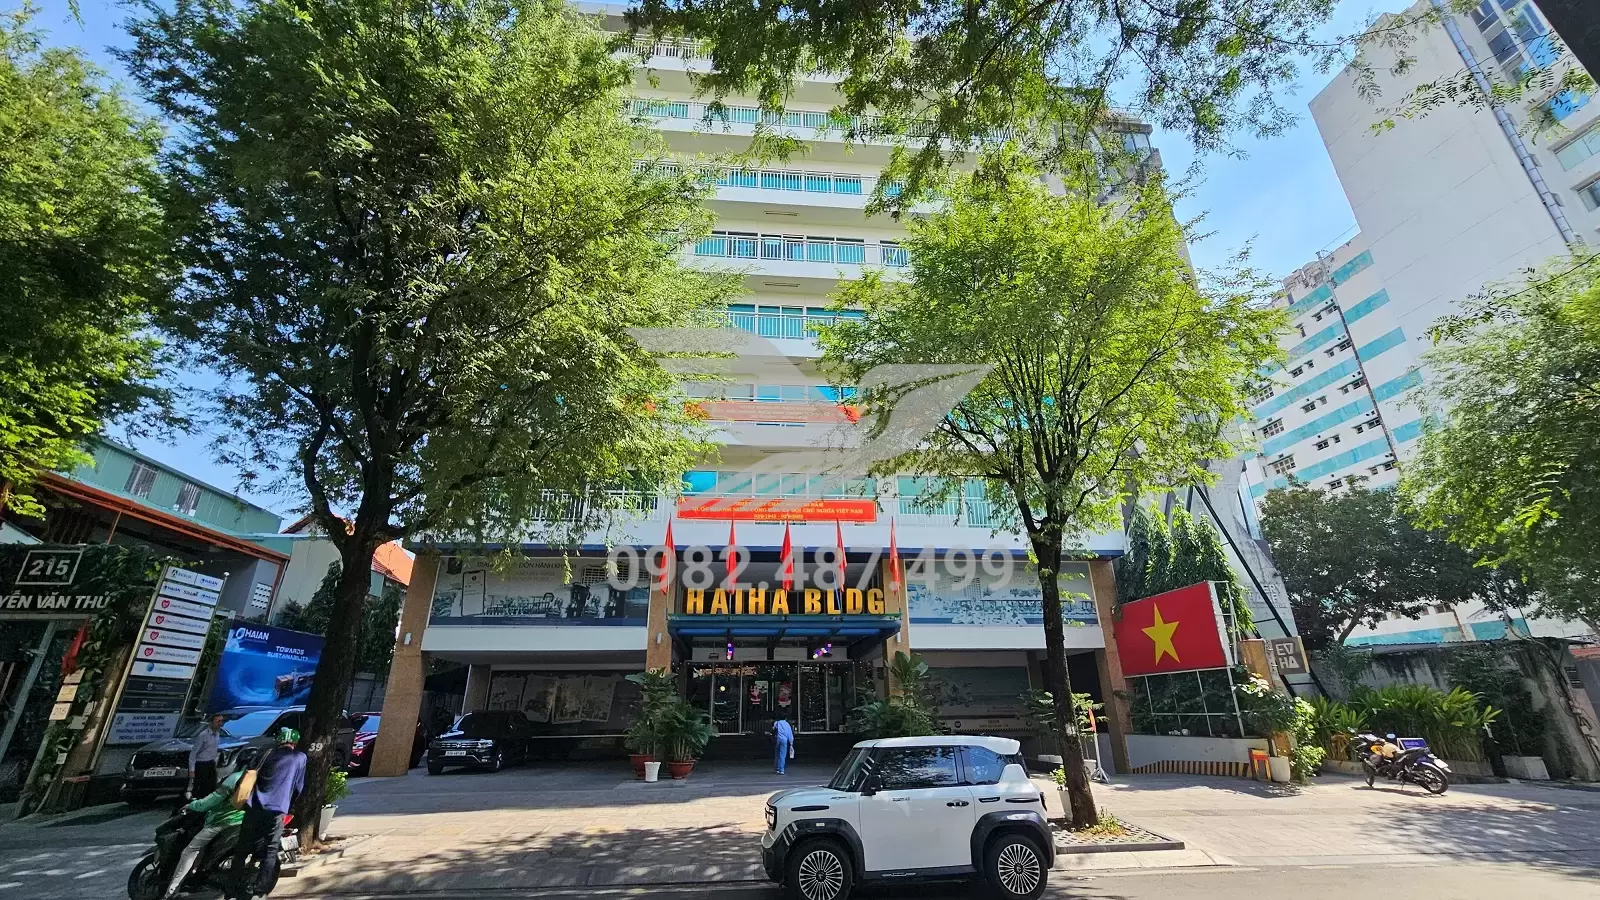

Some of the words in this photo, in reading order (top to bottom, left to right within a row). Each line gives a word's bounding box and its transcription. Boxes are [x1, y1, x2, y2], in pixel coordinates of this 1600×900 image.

[29, 559, 70, 576] 215
[37, 592, 72, 608] VĂN
[804, 588, 886, 615] BLDG
[244, 629, 270, 640] HAIAN
[276, 646, 304, 656] TOWARDS
[308, 742, 323, 752] 39
